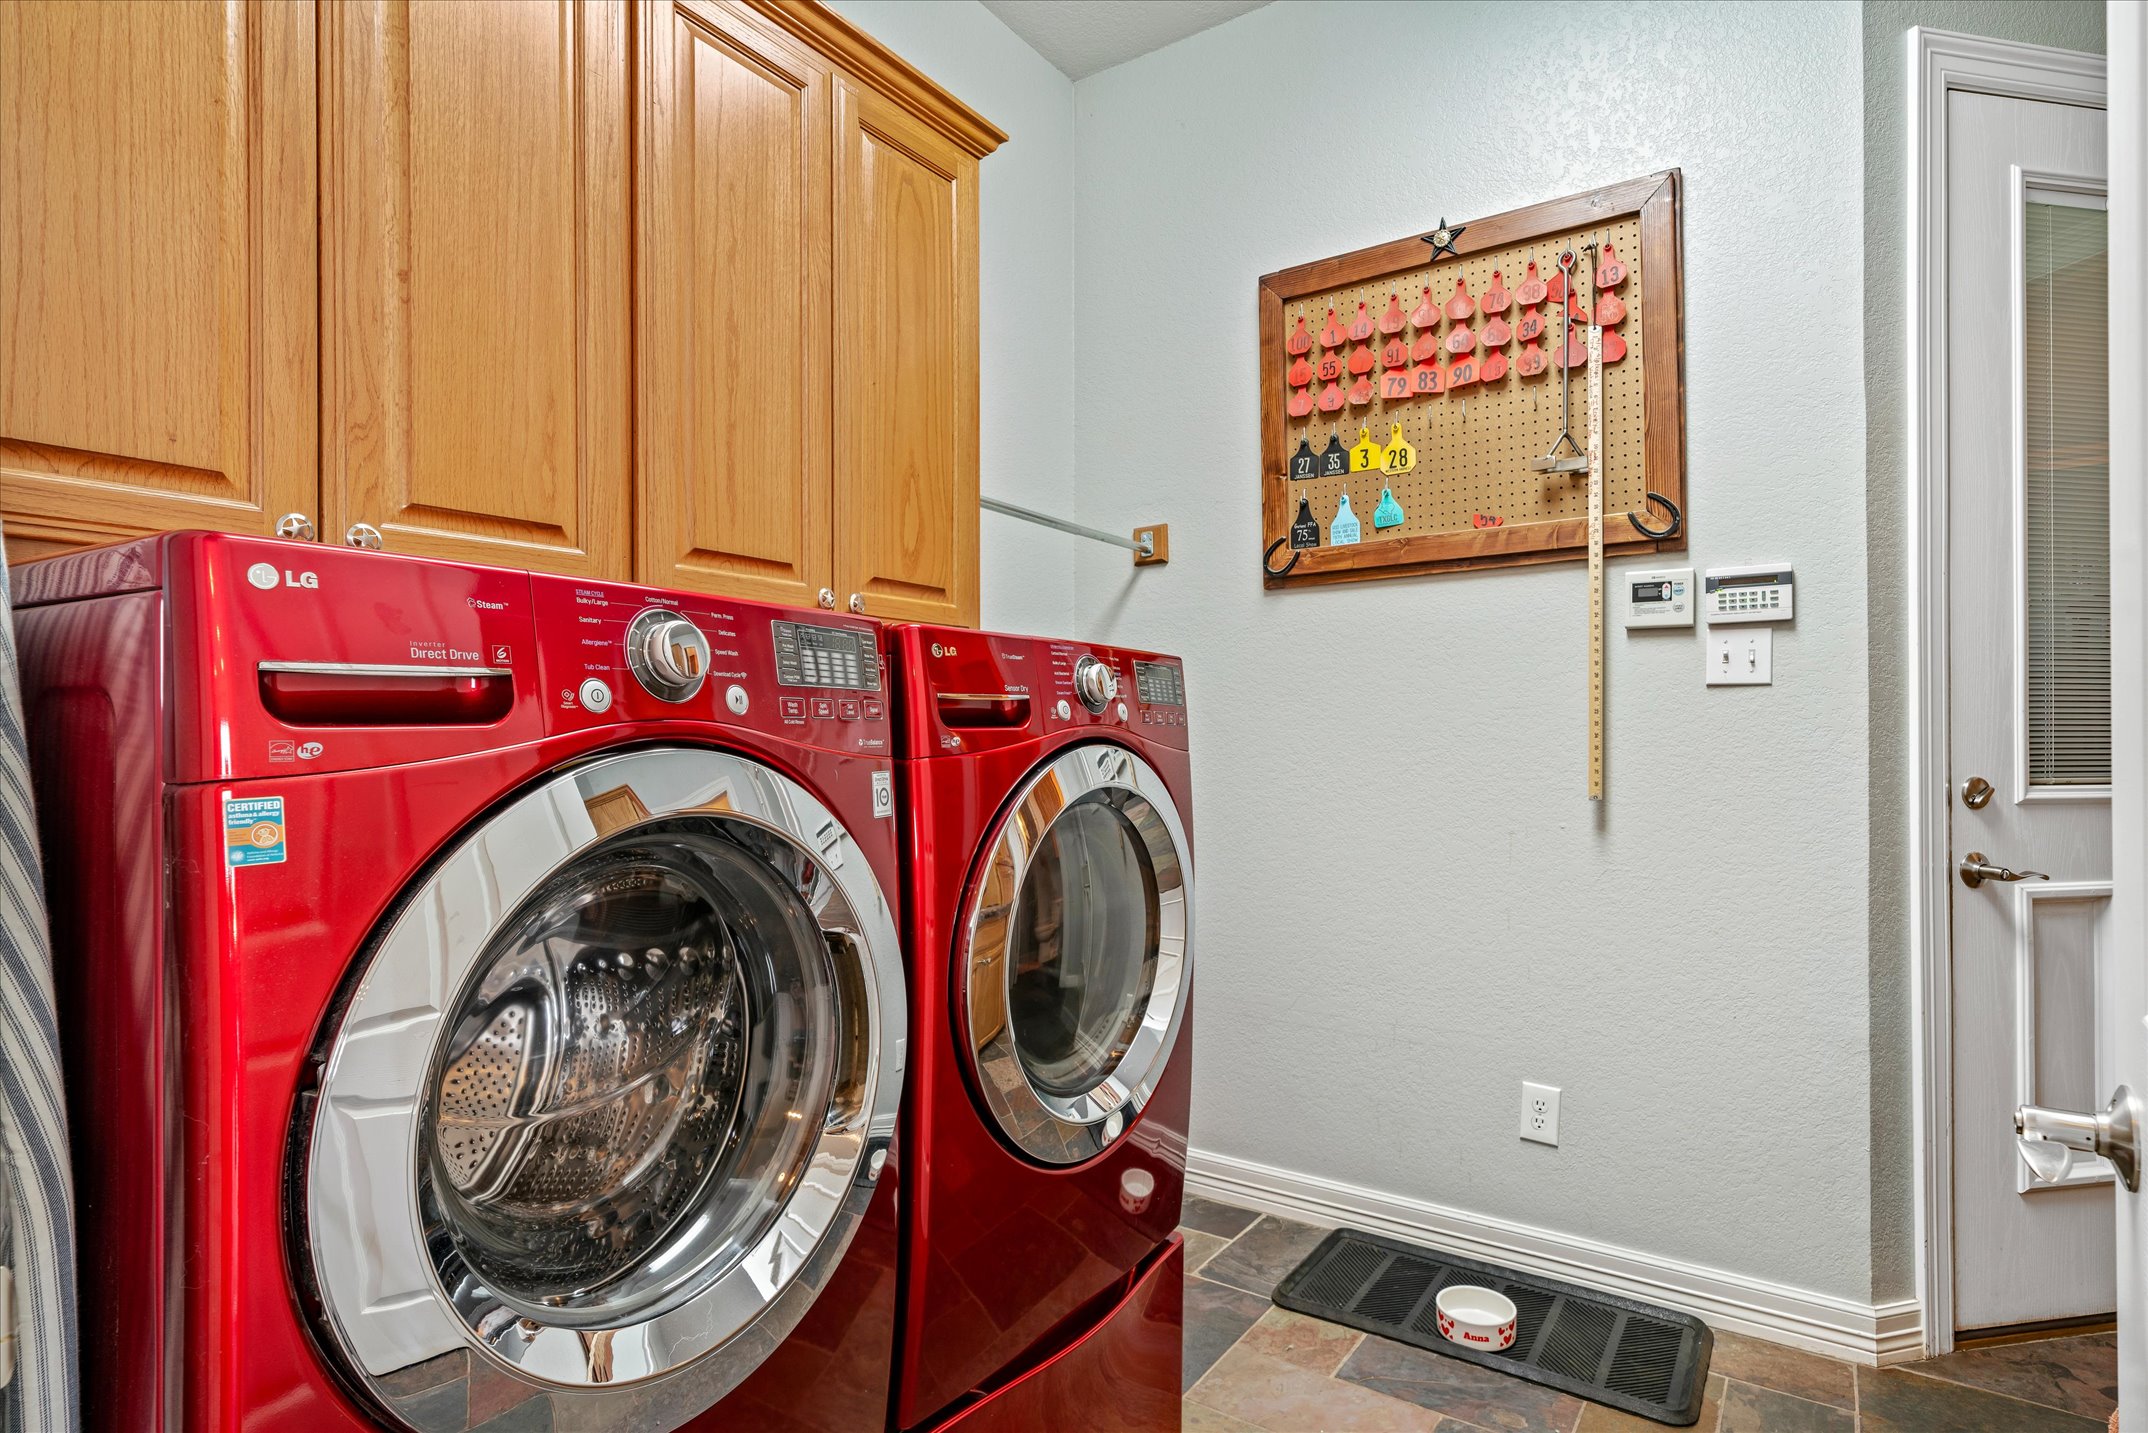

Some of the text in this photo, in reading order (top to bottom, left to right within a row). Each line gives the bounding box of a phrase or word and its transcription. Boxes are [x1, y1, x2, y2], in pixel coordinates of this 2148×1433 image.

[1601, 265, 1619, 286] 13
[1489, 291, 1504, 309] 74
[1523, 283, 1541, 301] 98
[1354, 322, 1367, 338] 14
[1522, 319, 1537, 338] 34
[1452, 333, 1469, 350] 64
[1386, 347, 1400, 364] 91
[1322, 360, 1336, 377] 55
[1453, 363, 1473, 385] 90
[1387, 376, 1407, 397] 79
[1418, 371, 1437, 391] 83
[1298, 457, 1311, 474] 27
[1328, 453, 1341, 470] 35
[1360, 448, 1369, 468] 3
[1388, 448, 1408, 469] 28
[285, 570, 319, 589] LG
[576, 596, 609, 607] Bulky/Large
[644, 596, 679, 606] Cotton/Normal
[579, 616, 602, 625] Sanitary
[718, 629, 736, 637] Delicates
[409, 640, 446, 648] Inverter
[943, 646, 957, 656] LG
[410, 647, 479, 661] Direct Drive
[594, 663, 610, 671] Clean
[1004, 684, 1029, 693] Sensor Dry
[876, 787, 890, 807] 10
[227, 800, 281, 813] CERTIFIED
[1463, 1331, 1490, 1343] Anna
